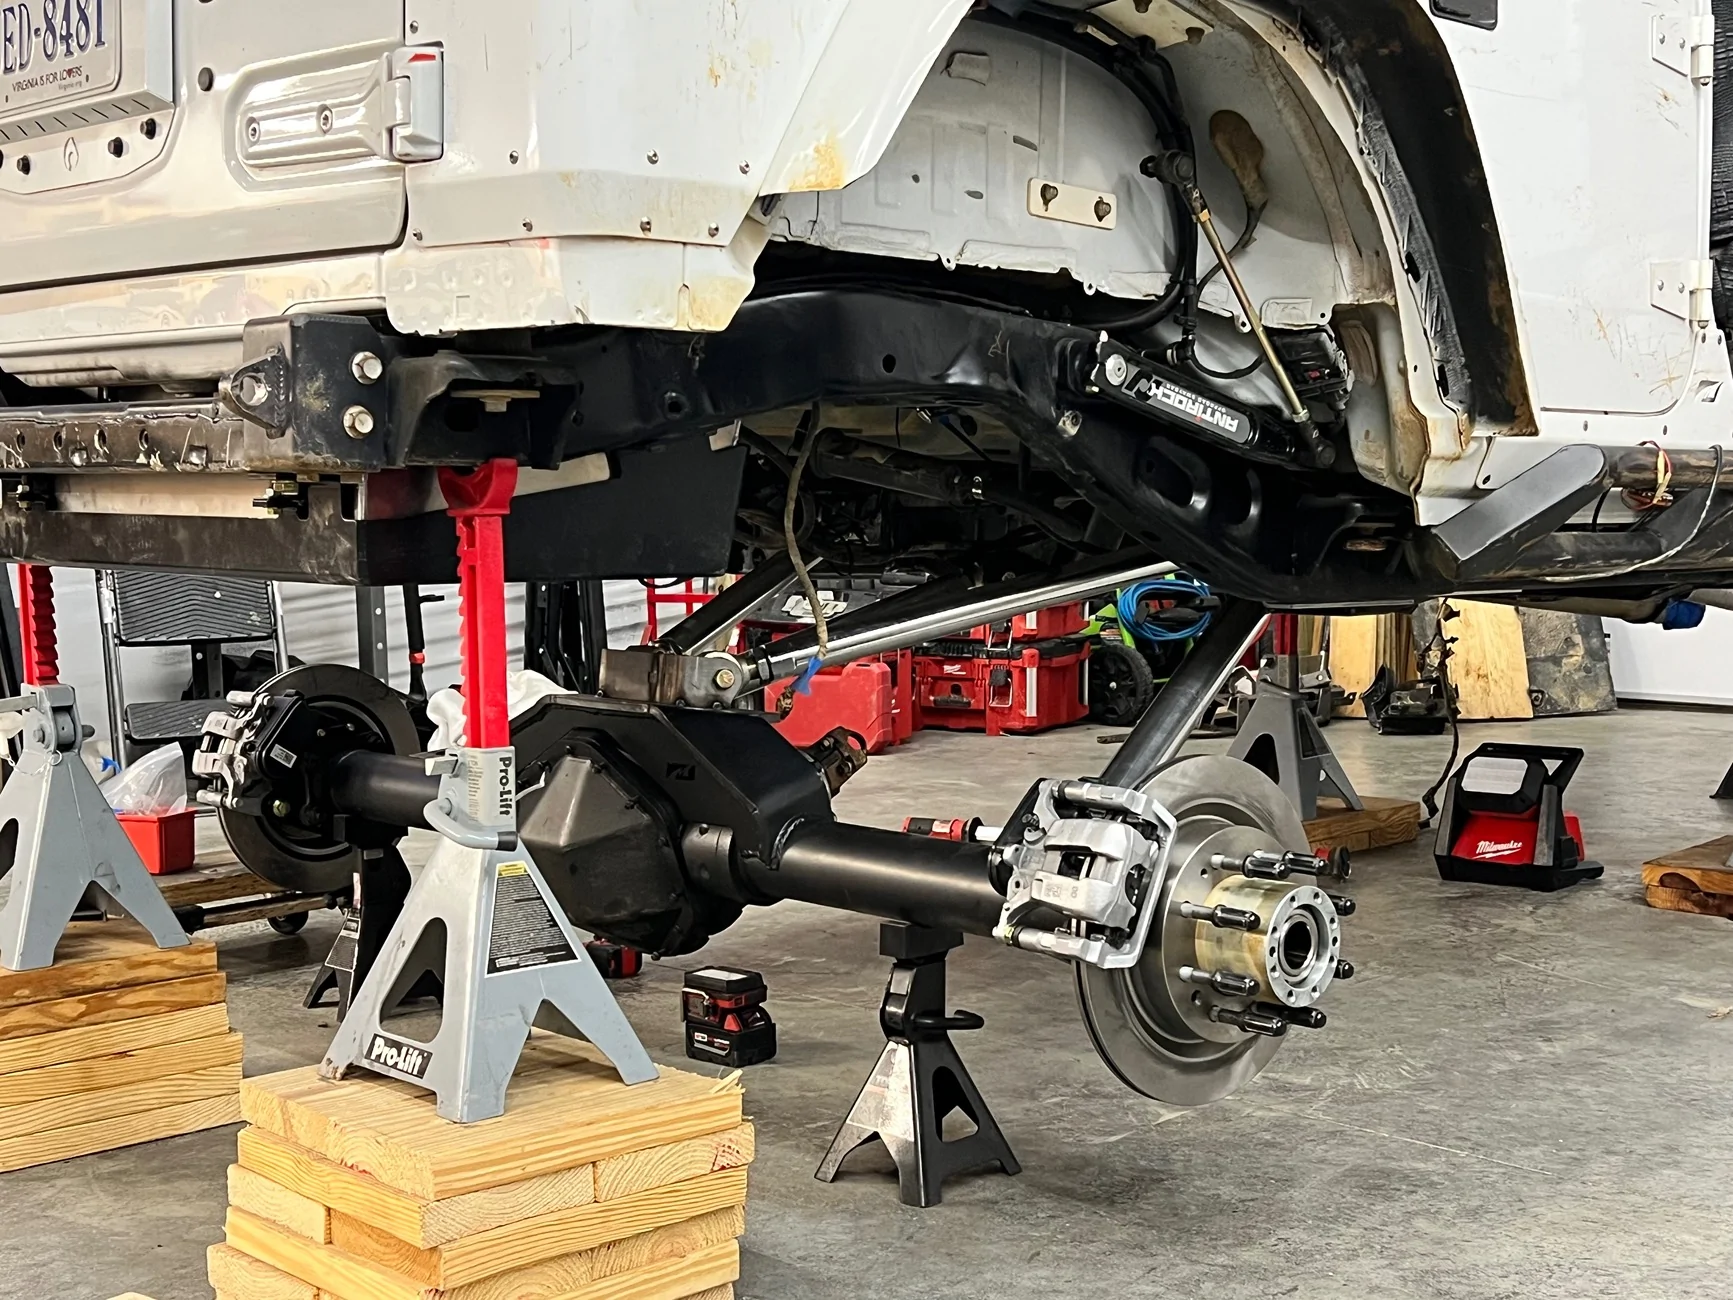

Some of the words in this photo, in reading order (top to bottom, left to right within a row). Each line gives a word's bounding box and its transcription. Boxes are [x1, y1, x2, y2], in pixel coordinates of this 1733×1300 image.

[2, 0, 106, 75] ED-8481
[12, 77, 38, 92] VIRGINIA
[40, 76, 45, 86] IS
[46, 72, 58, 85] FOR
[1147, 382, 1240, 433] ANTIROCK
[1166, 383, 1196, 400] SWAYBAR
[1197, 397, 1227, 413] OFFROAD
[499, 757, 513, 816] Pro-Lift
[370, 1036, 423, 1075] Pro-Lift
